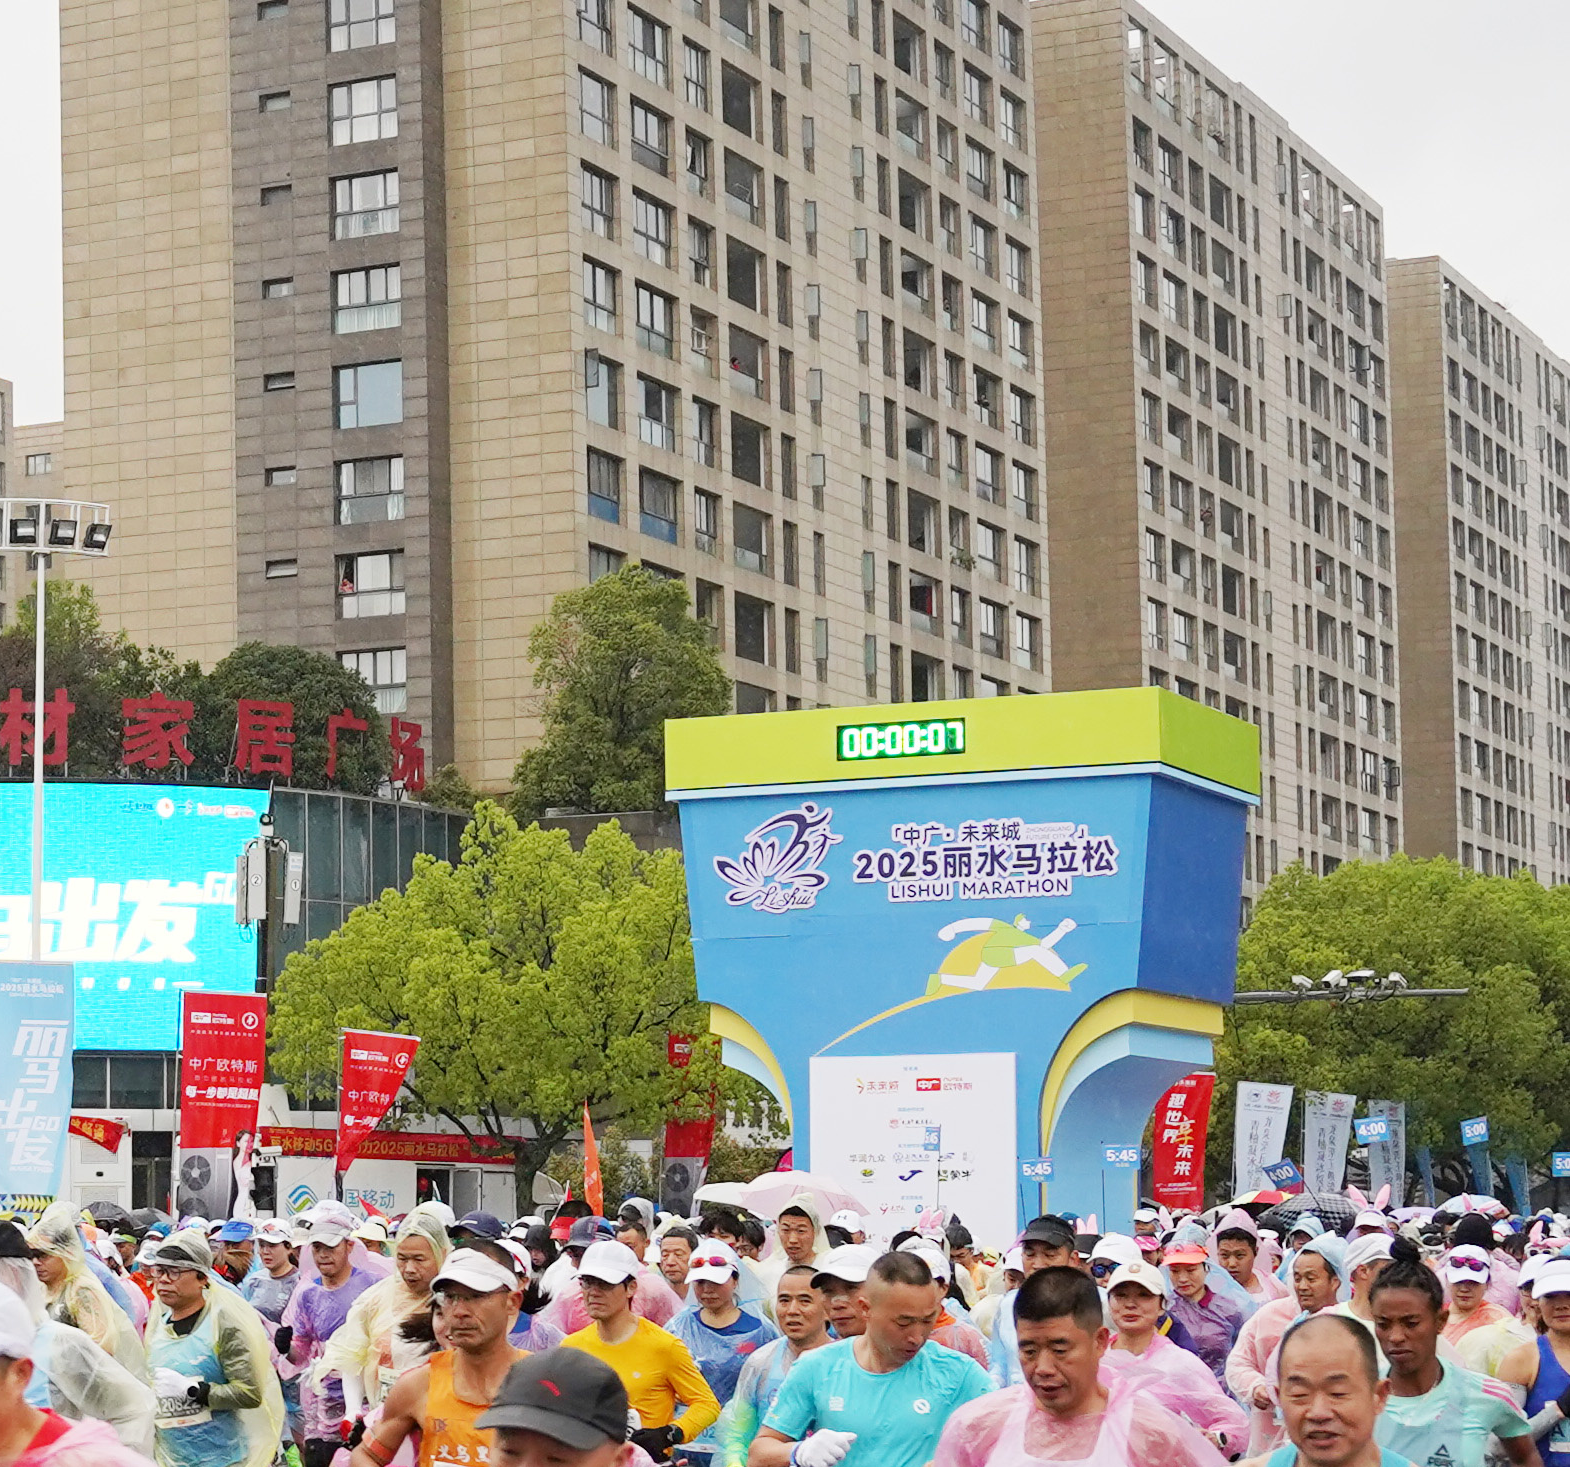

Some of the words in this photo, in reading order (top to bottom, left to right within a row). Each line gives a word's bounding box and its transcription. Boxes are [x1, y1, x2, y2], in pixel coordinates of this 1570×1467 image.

[841, 721, 964, 758] 00:00:07
[855, 843, 1117, 881] 2025丽水马拉松
[890, 880, 952, 900] LISHUI
[961, 877, 1070, 898] MARATHON
[189, 1056, 258, 1074] 中广欧特斯
[1357, 1121, 1387, 1136] 4:00
[1463, 1122, 1487, 1138] 5:00
[360, 1139, 460, 1158] 力2025丽水马拉松
[1105, 1149, 1138, 1162] 5:45
[1022, 1163, 1053, 1176] 5:45
[1555, 1157, 1570, 1170] 5:0
[1269, 1166, 1295, 1184] 4:00
